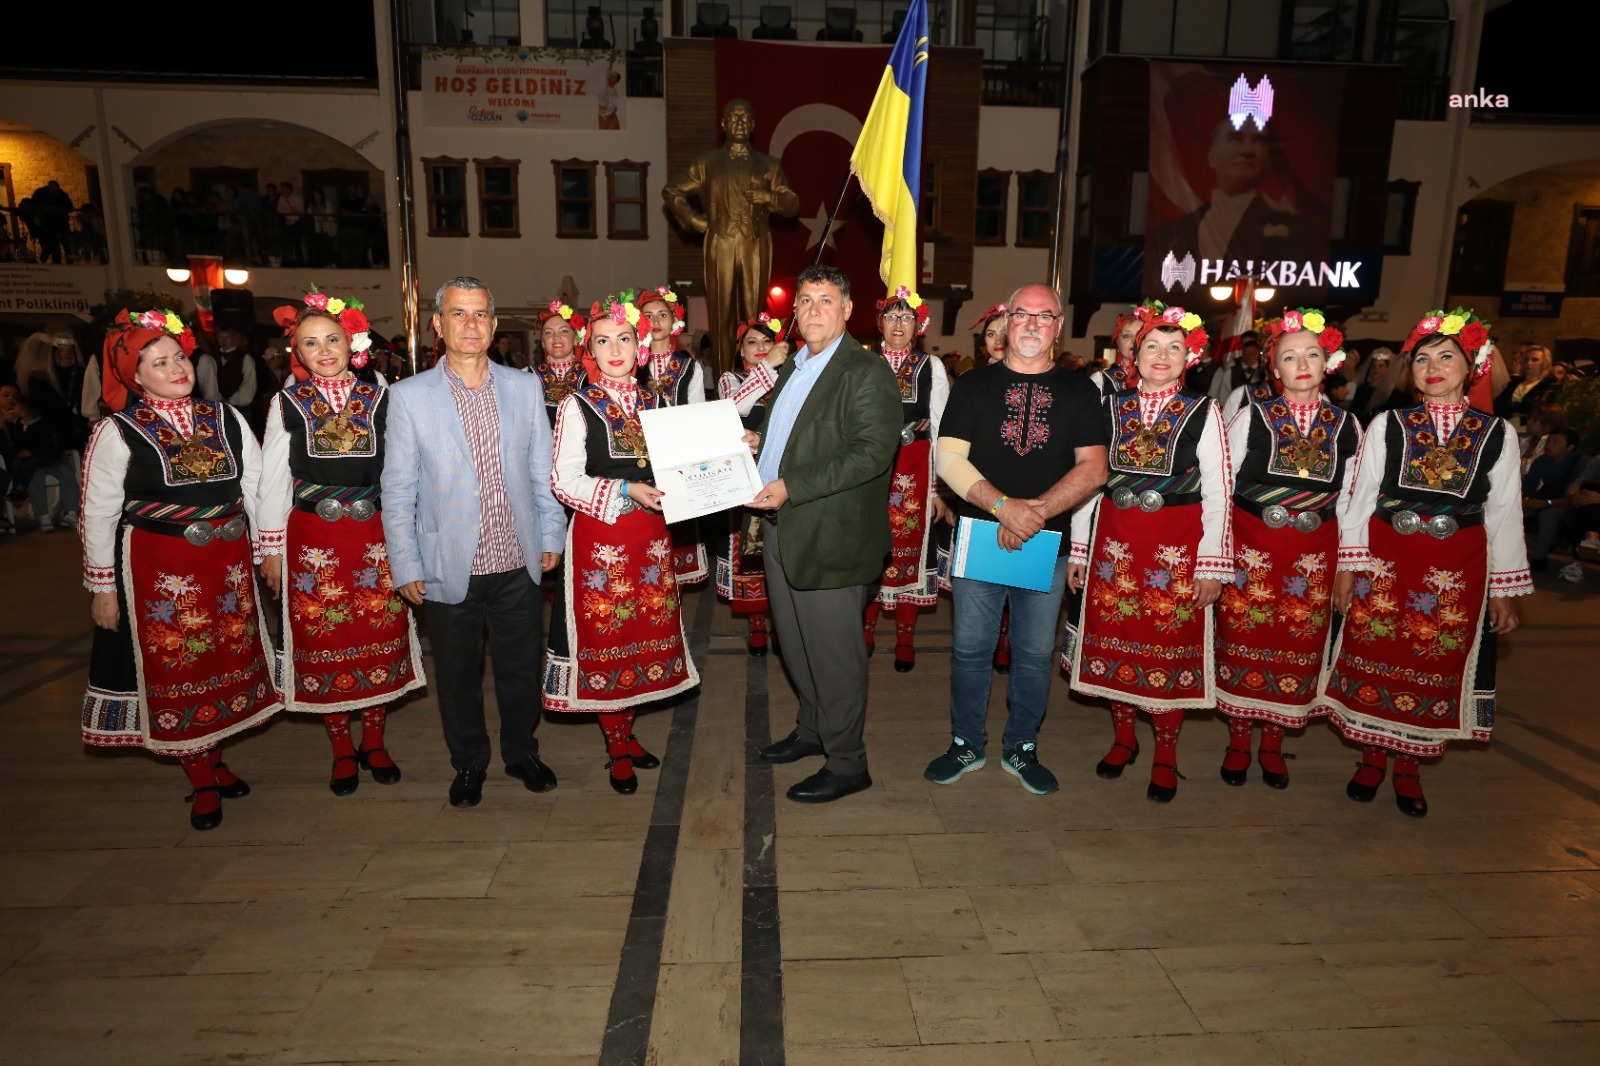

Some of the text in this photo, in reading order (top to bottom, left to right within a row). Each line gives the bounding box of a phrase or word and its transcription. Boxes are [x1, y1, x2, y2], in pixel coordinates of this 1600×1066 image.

[434, 76, 477, 97] HOŞ
[487, 98, 536, 108] WELCOME
[16, 298, 89, 312] Polikliniği
